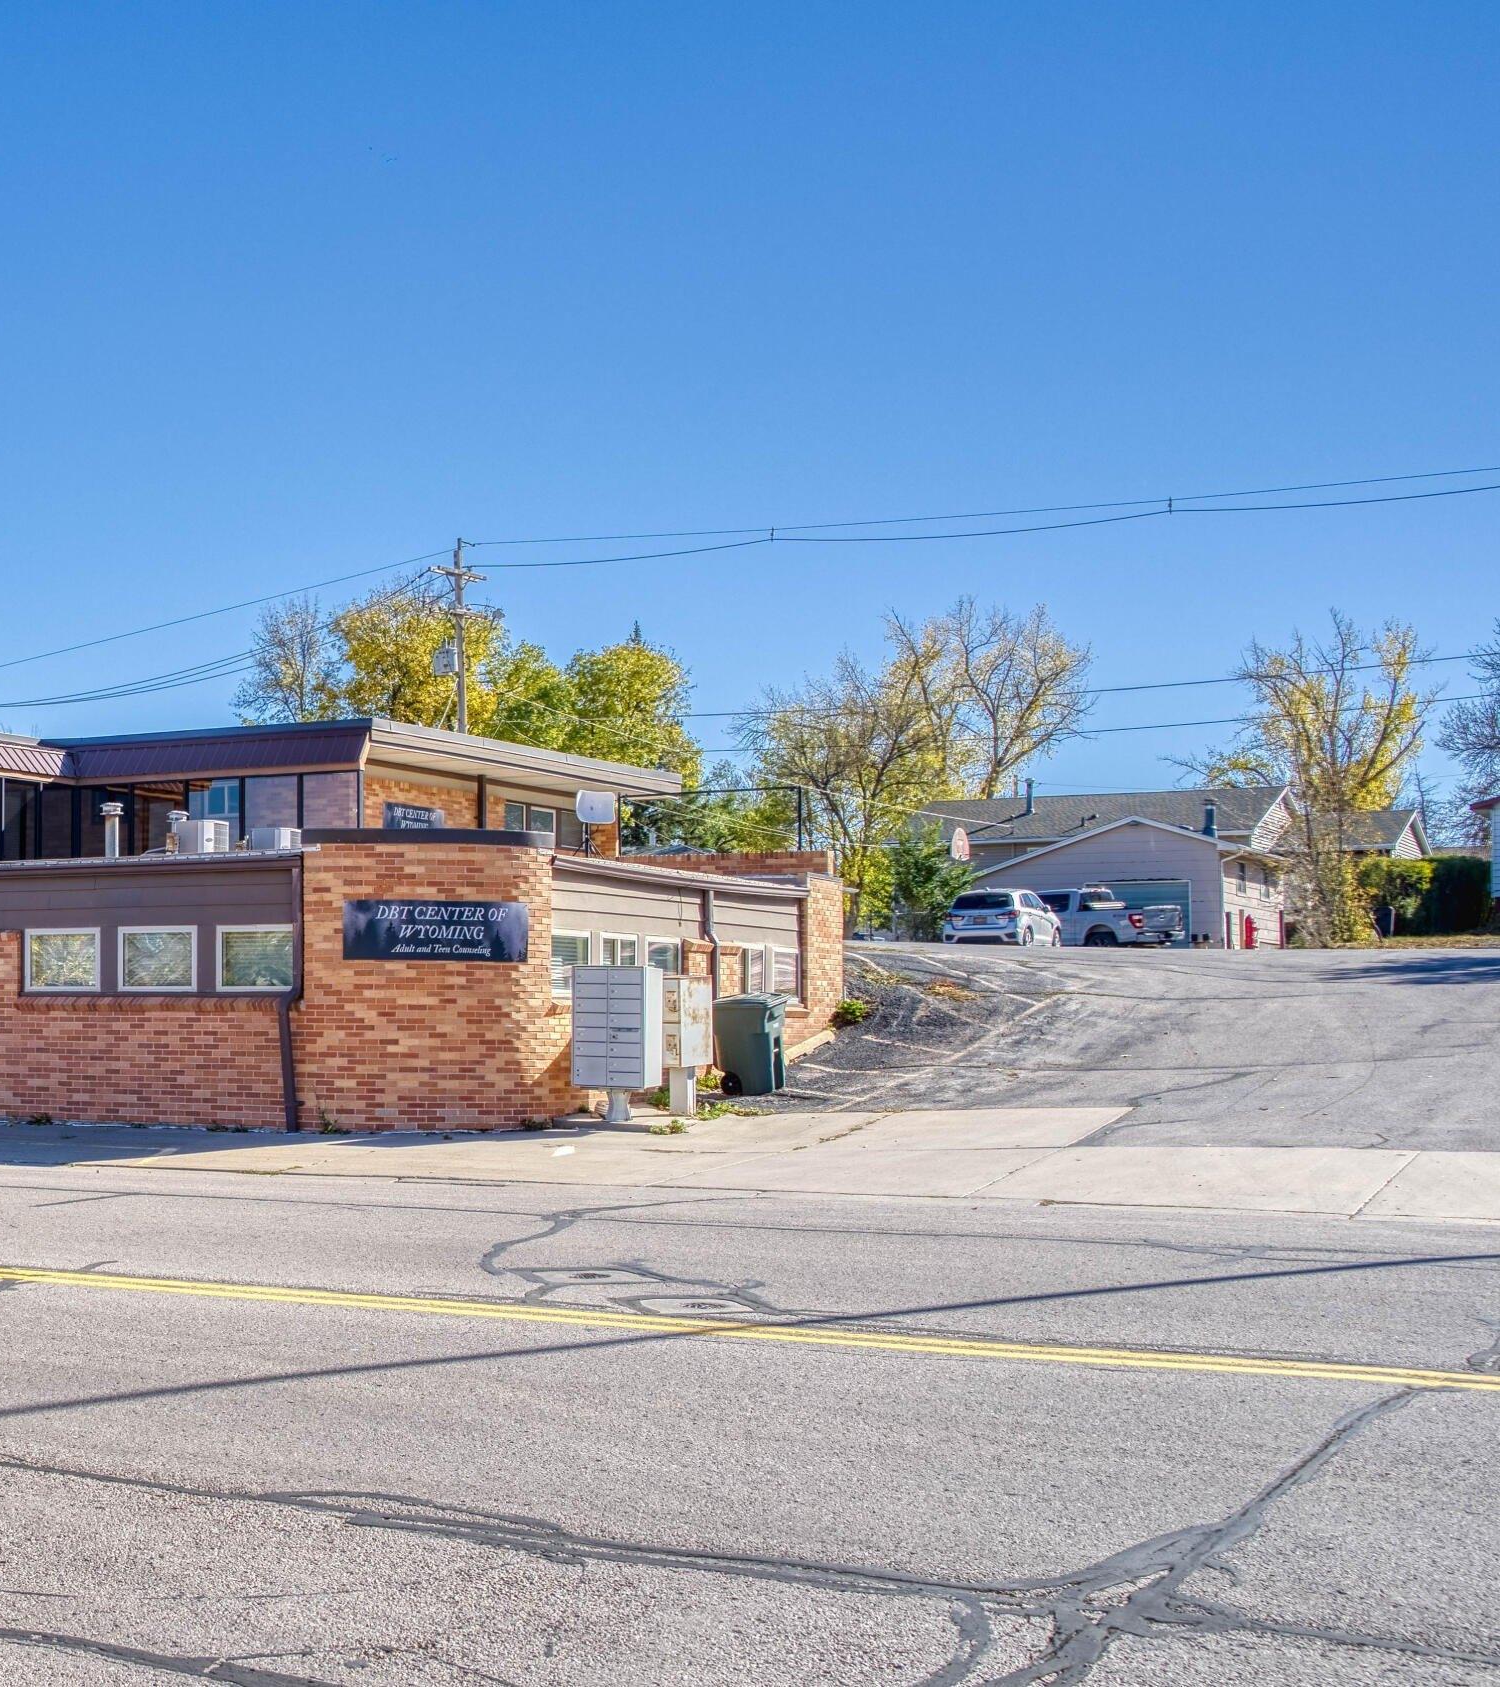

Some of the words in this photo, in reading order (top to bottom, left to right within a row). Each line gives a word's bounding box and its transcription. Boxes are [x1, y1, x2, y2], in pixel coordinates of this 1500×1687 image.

[375, 904, 412, 920] DBT
[414, 905, 485, 921] CENTER
[488, 907, 509, 921] OF
[398, 924, 485, 940] WYOMING
[391, 943, 415, 953] Adult
[416, 944, 431, 953] and
[433, 944, 451, 954] Teen
[452, 944, 492, 957] Counseling
